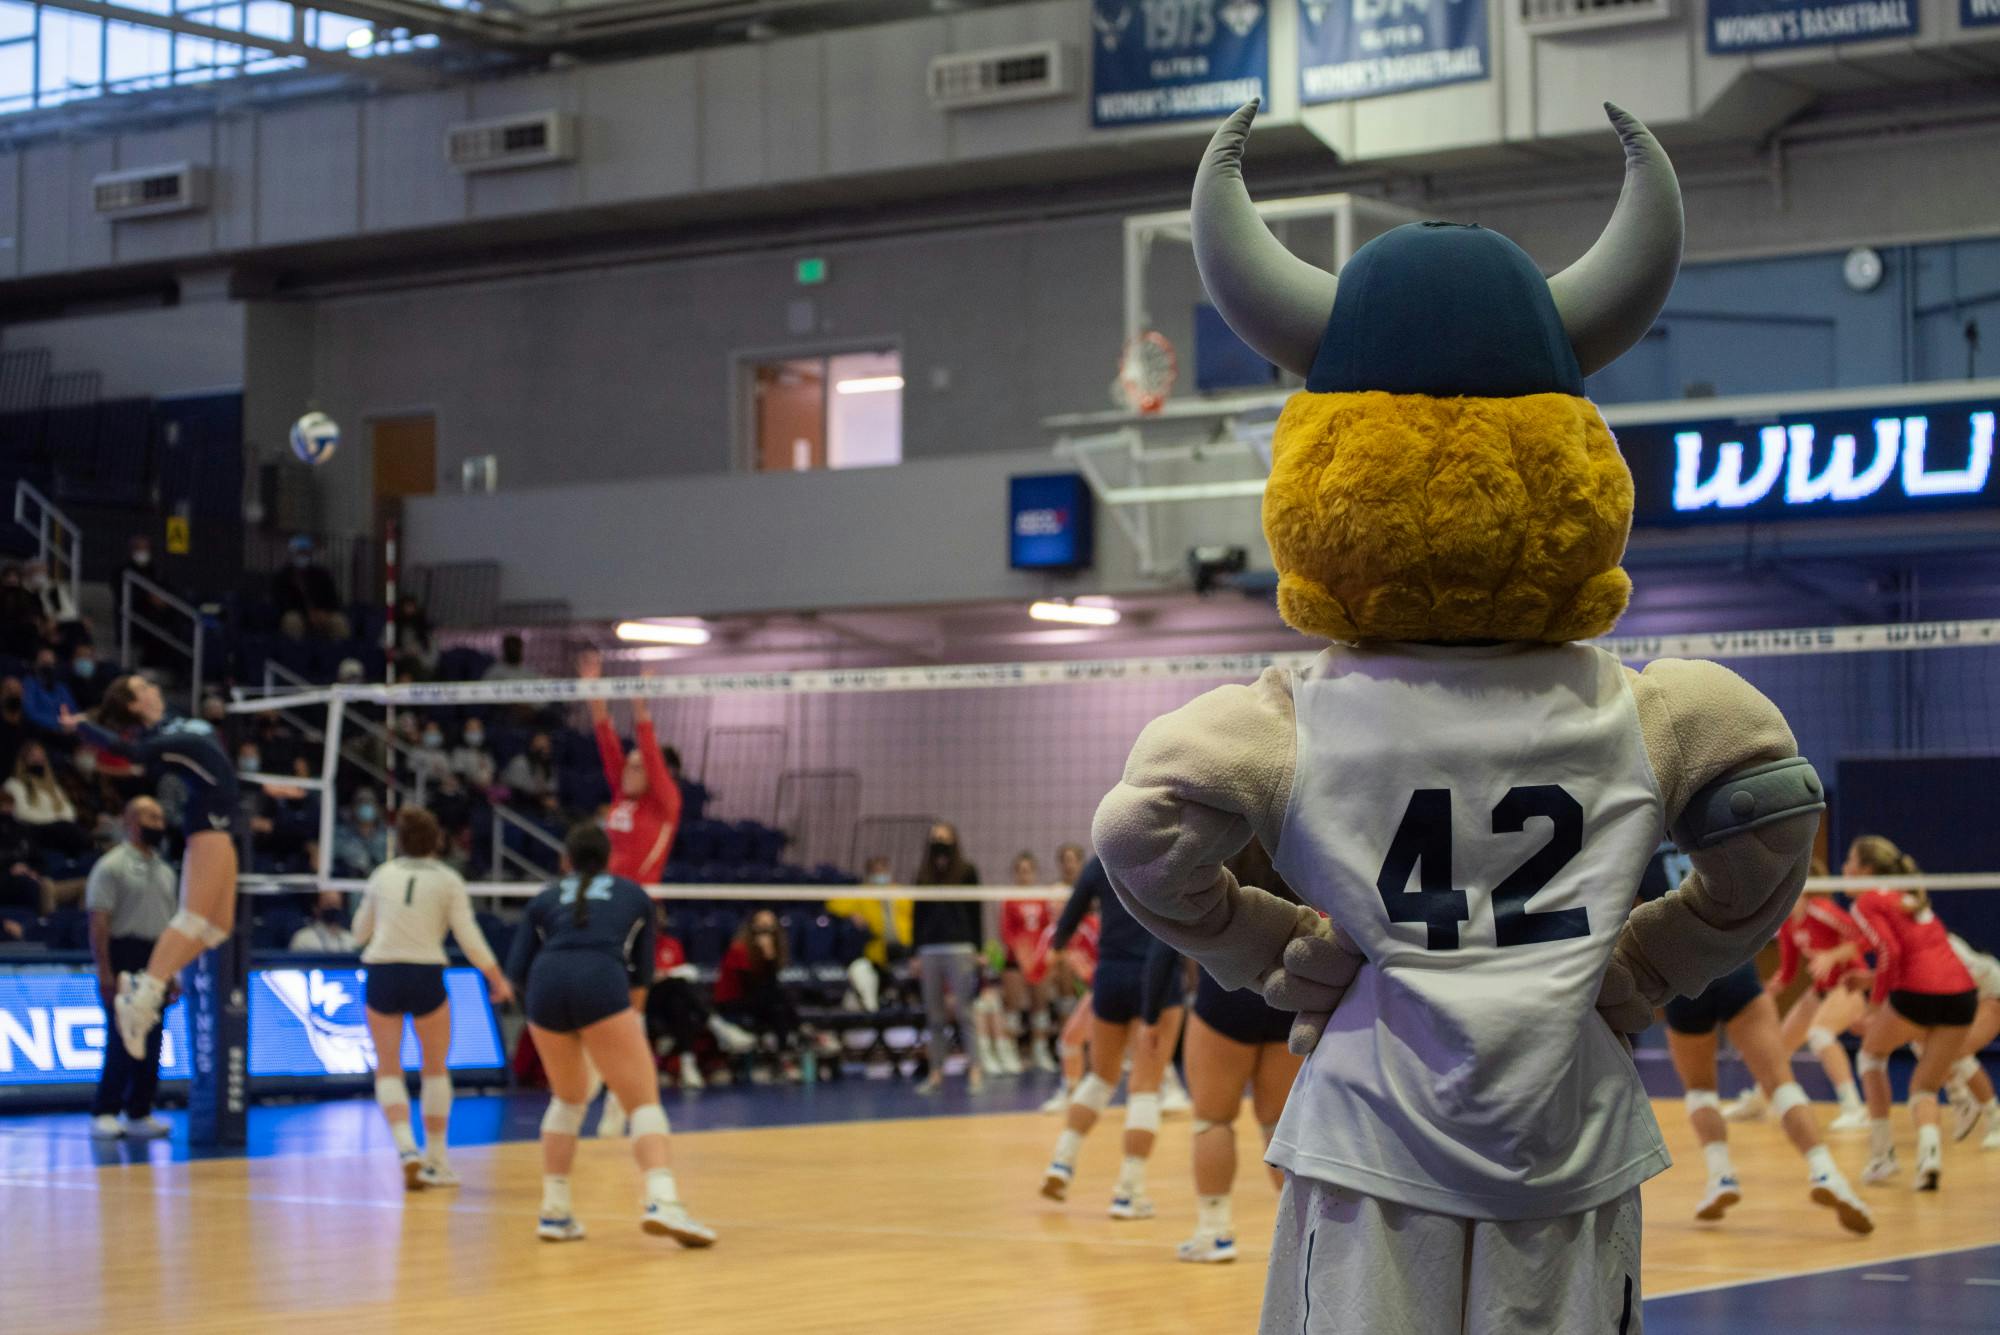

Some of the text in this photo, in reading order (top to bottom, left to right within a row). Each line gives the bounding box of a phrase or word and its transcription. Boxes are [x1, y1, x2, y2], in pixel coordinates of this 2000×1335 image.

[1714, 0, 1910, 46] WOMEN'S BASKETBALL
[1303, 45, 1483, 95] WOMEN'S BASKETBALL
[1096, 88, 1168, 121] WOMEN'S
[1673, 411, 1994, 511] WWU
[1711, 629, 1835, 651] VIKINGS
[1886, 622, 1961, 643] WWU
[1377, 784, 1591, 951] 42
[404, 876, 418, 907] 1
